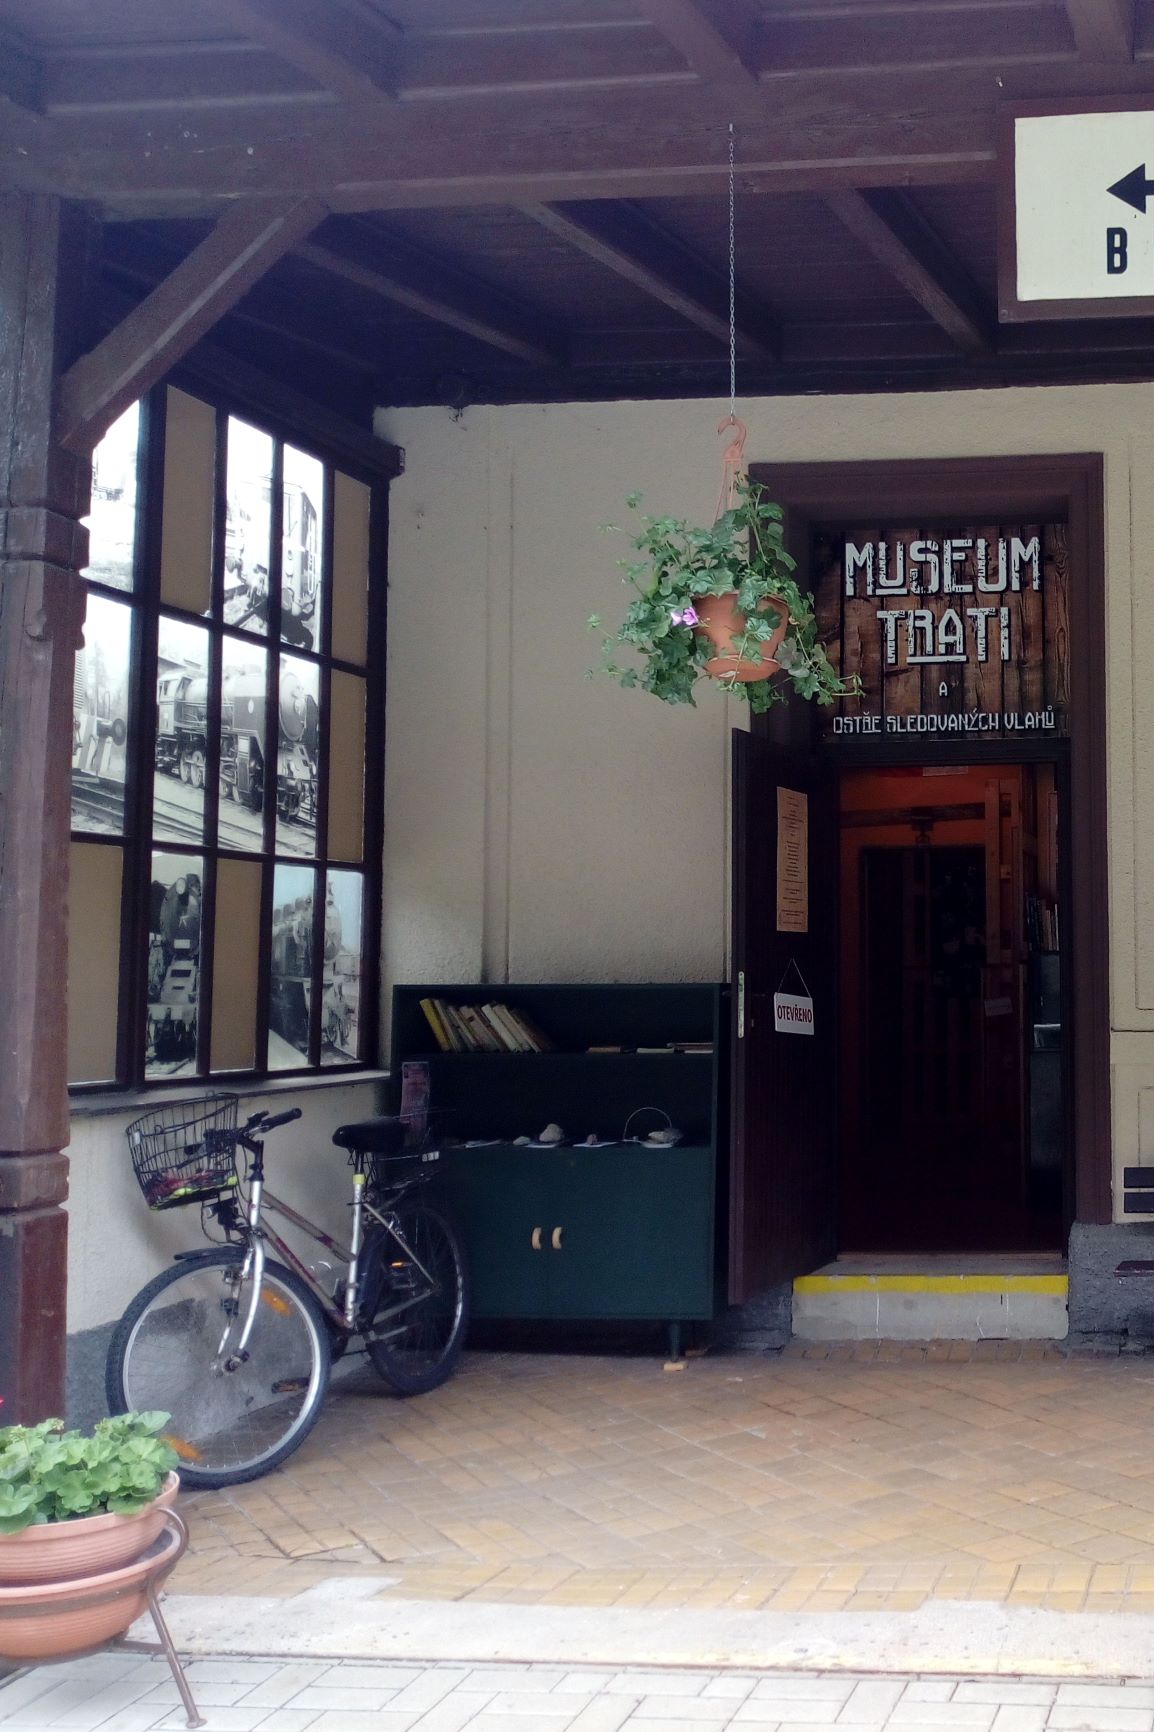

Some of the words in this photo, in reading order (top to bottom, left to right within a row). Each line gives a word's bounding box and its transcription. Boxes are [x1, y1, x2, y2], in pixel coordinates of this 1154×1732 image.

[845, 536, 1041, 596] MUSEUM
[877, 607, 1009, 664] TRATI
[938, 681, 948, 697] A
[833, 712, 882, 734] OSTŘE
[886, 708, 999, 733] SLEDOVANÝCH
[777, 1004, 813, 1023] OTEVŘENO
